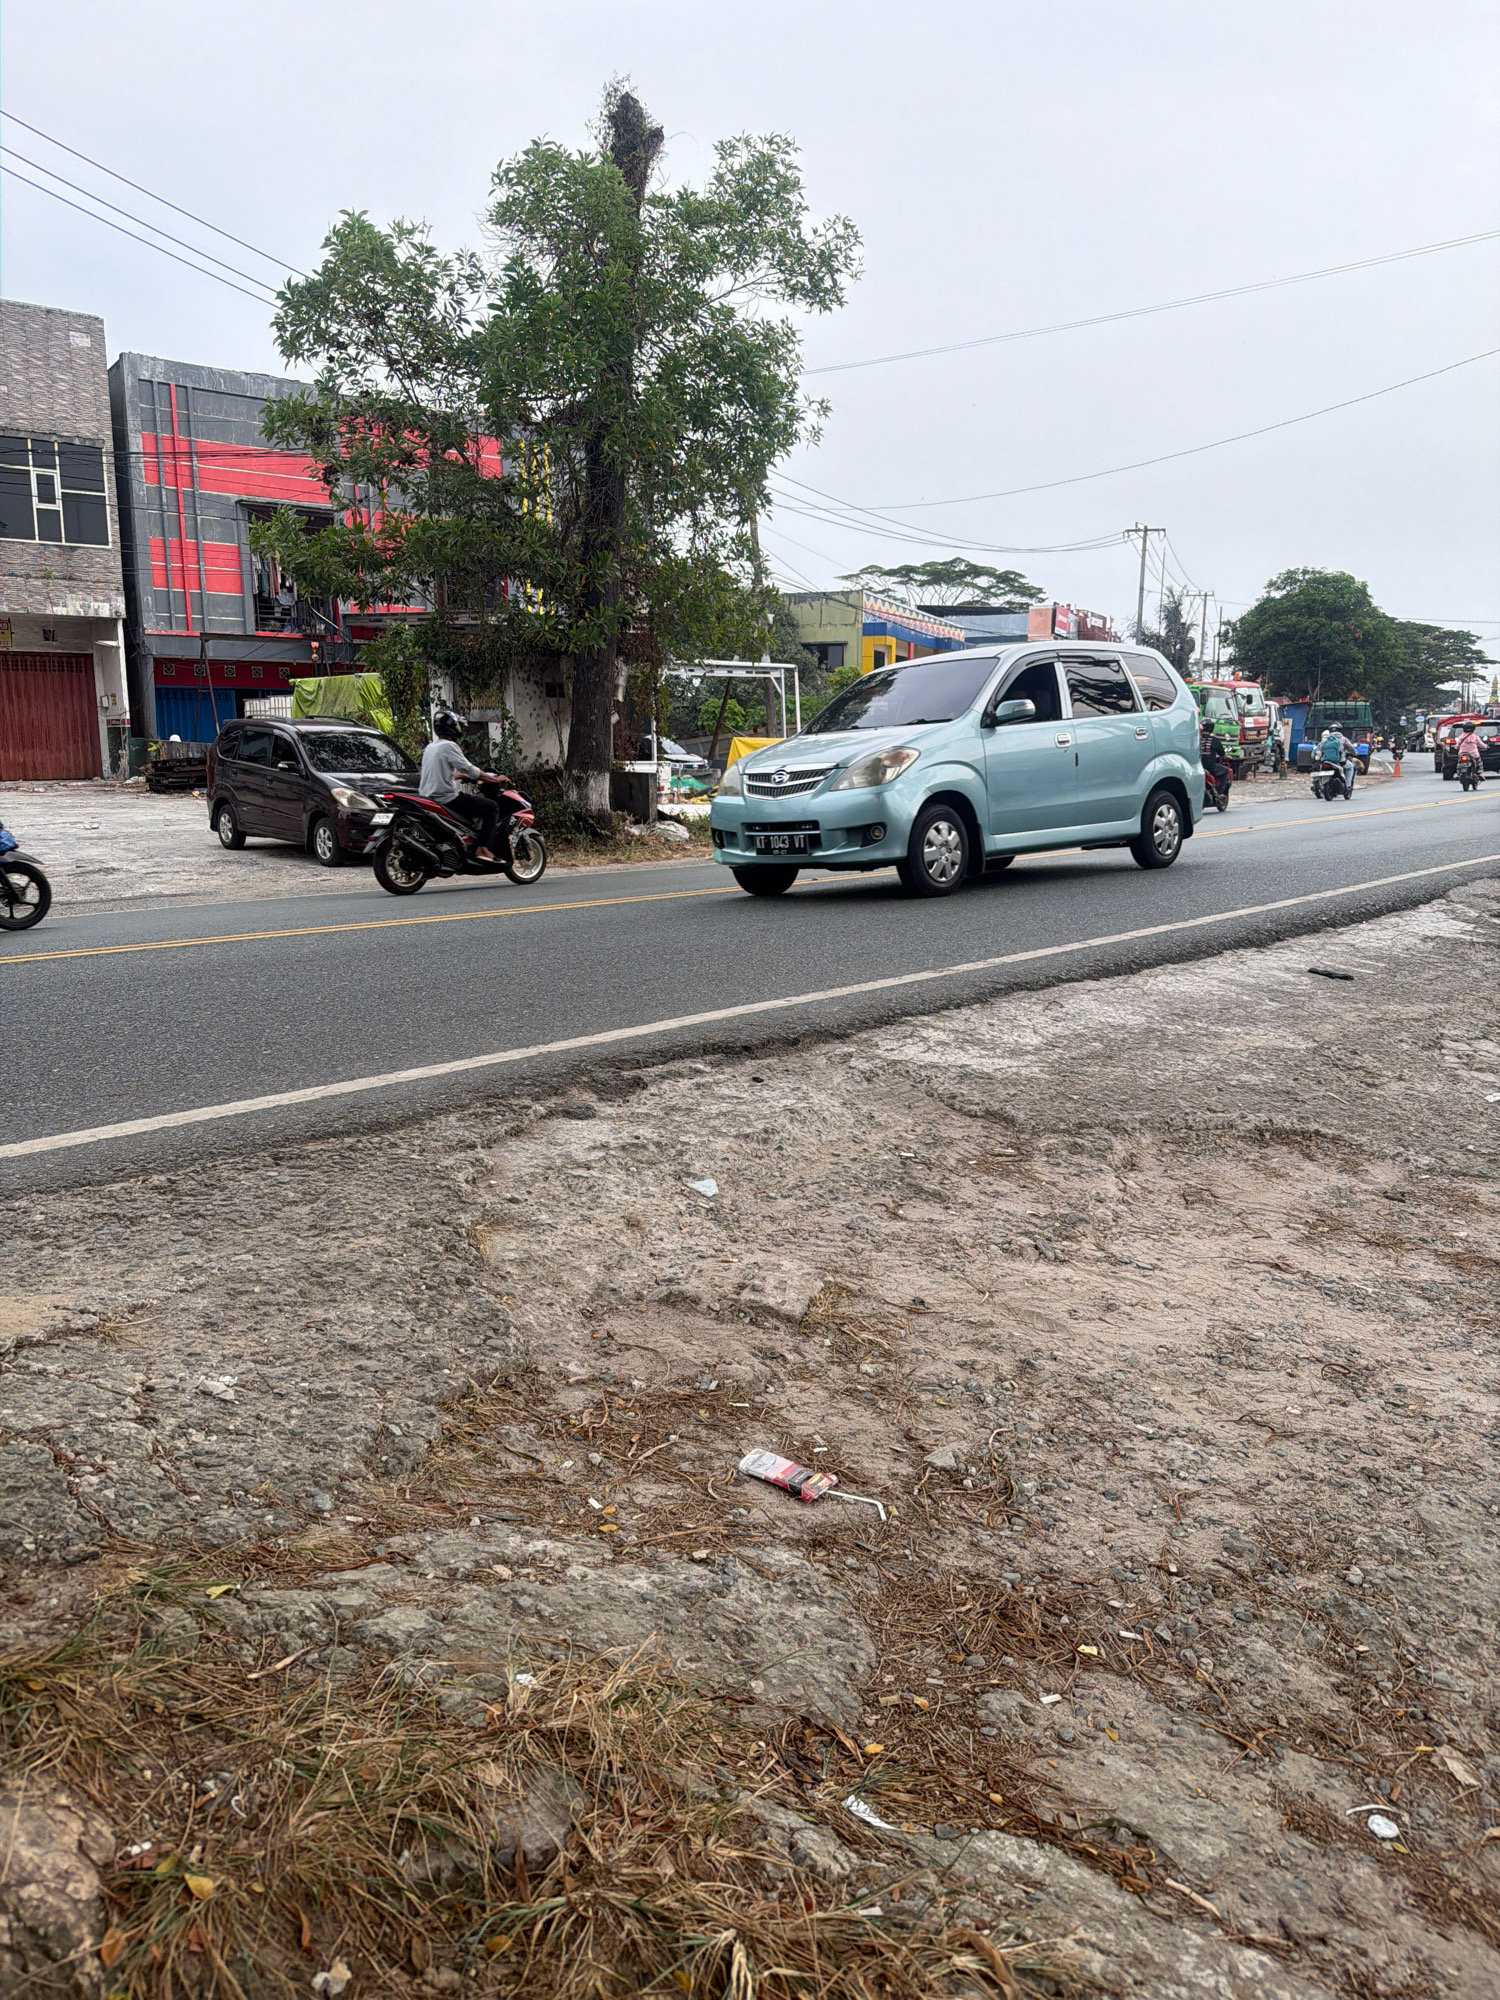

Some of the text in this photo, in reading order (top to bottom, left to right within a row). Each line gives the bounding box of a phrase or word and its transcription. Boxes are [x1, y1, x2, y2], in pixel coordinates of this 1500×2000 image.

[756, 835, 804, 848] KT 1043 VT
